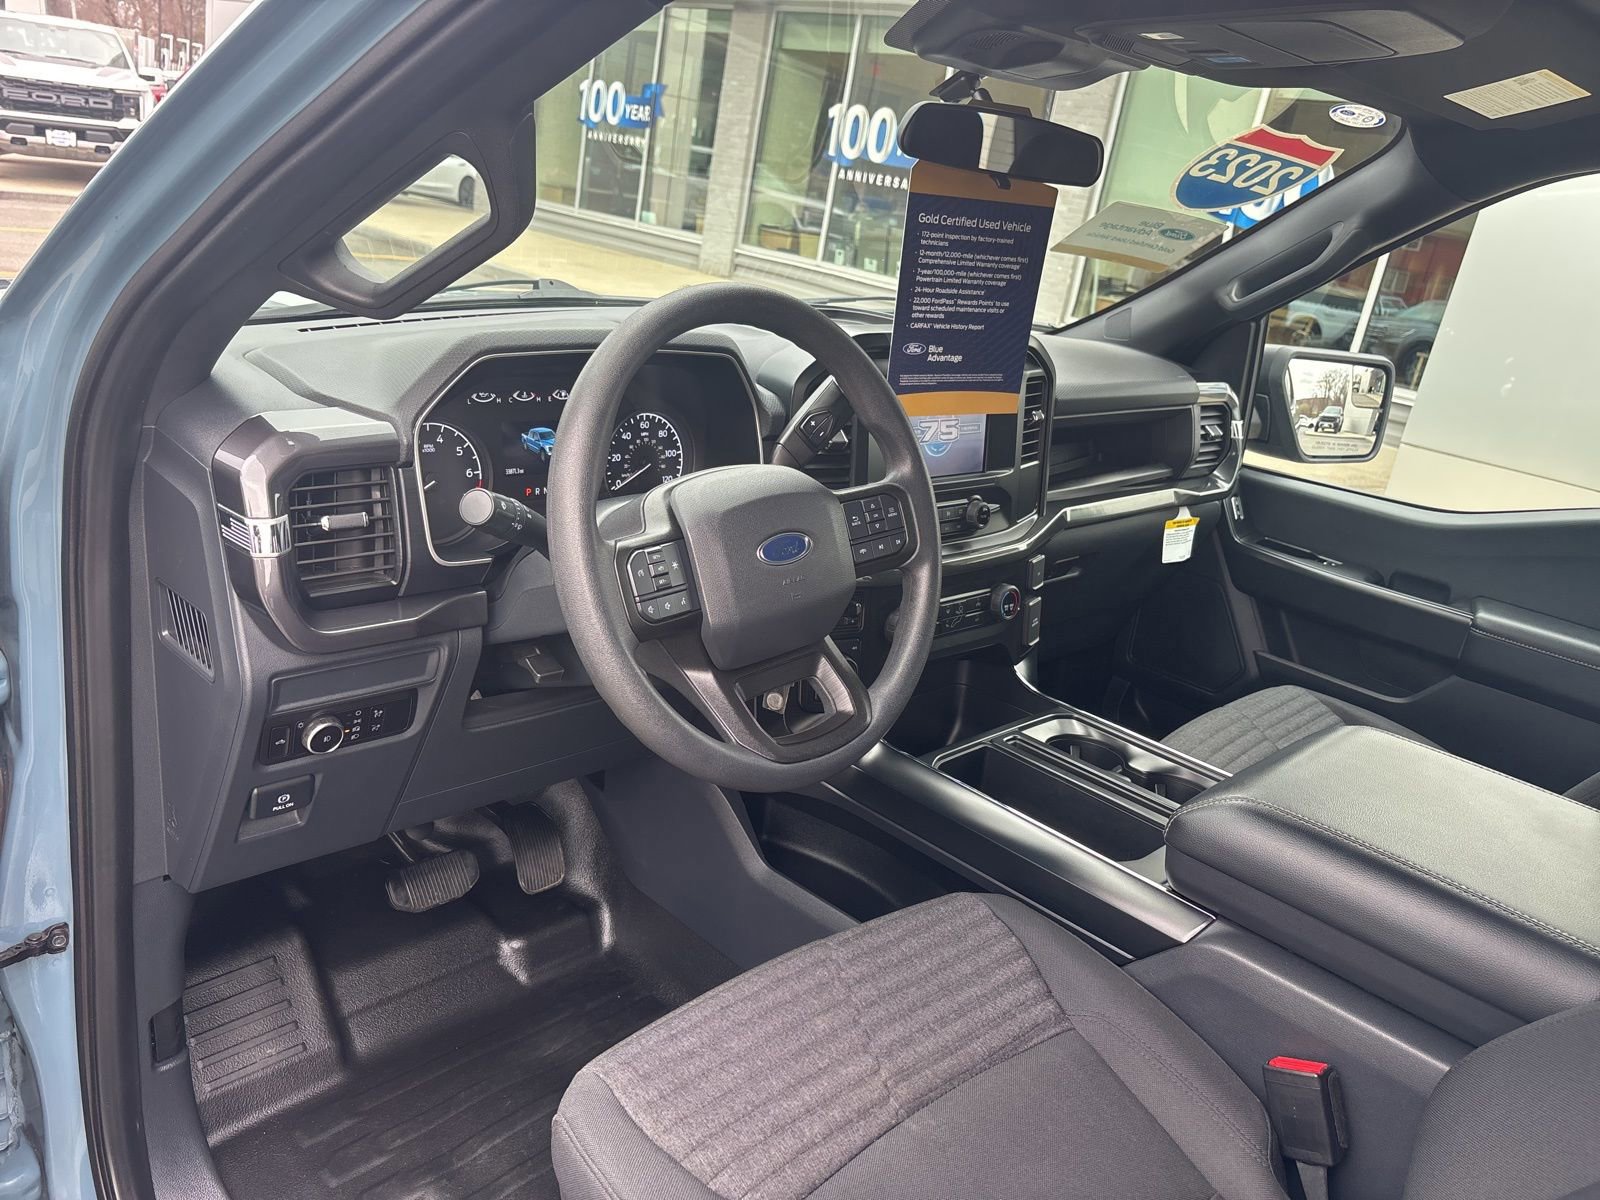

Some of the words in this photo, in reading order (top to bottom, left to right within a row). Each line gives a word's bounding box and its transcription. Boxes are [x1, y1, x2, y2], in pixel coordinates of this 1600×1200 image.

[2, 88, 113, 109] FORD
[579, 80, 626, 125] 100
[625, 104, 651, 121] YEAR
[588, 131, 645, 146] ANNIVERSARY
[828, 103, 897, 164] 100
[919, 213, 939, 223] Gold
[941, 215, 976, 228] Certified
[979, 219, 1000, 230] Used
[1002, 221, 1031, 232] Vehicle
[922, 231, 944, 239] 172-point
[978, 235, 1014, 244] factory-trained
[920, 250, 973, 259] 12-month/12,000-mile
[918, 257, 956, 266] Comprehensive
[976, 261, 997, 269] Warranty
[968, 271, 993, 279] (whichever
[962, 278, 984, 286] Warranty
[927, 354, 962, 363] Advantage
[919, 418, 959, 444] 75
[436, 434, 443, 443] 4
[456, 446, 463, 456] 5
[612, 454, 621, 462] 20
[466, 468, 473, 477] 6
